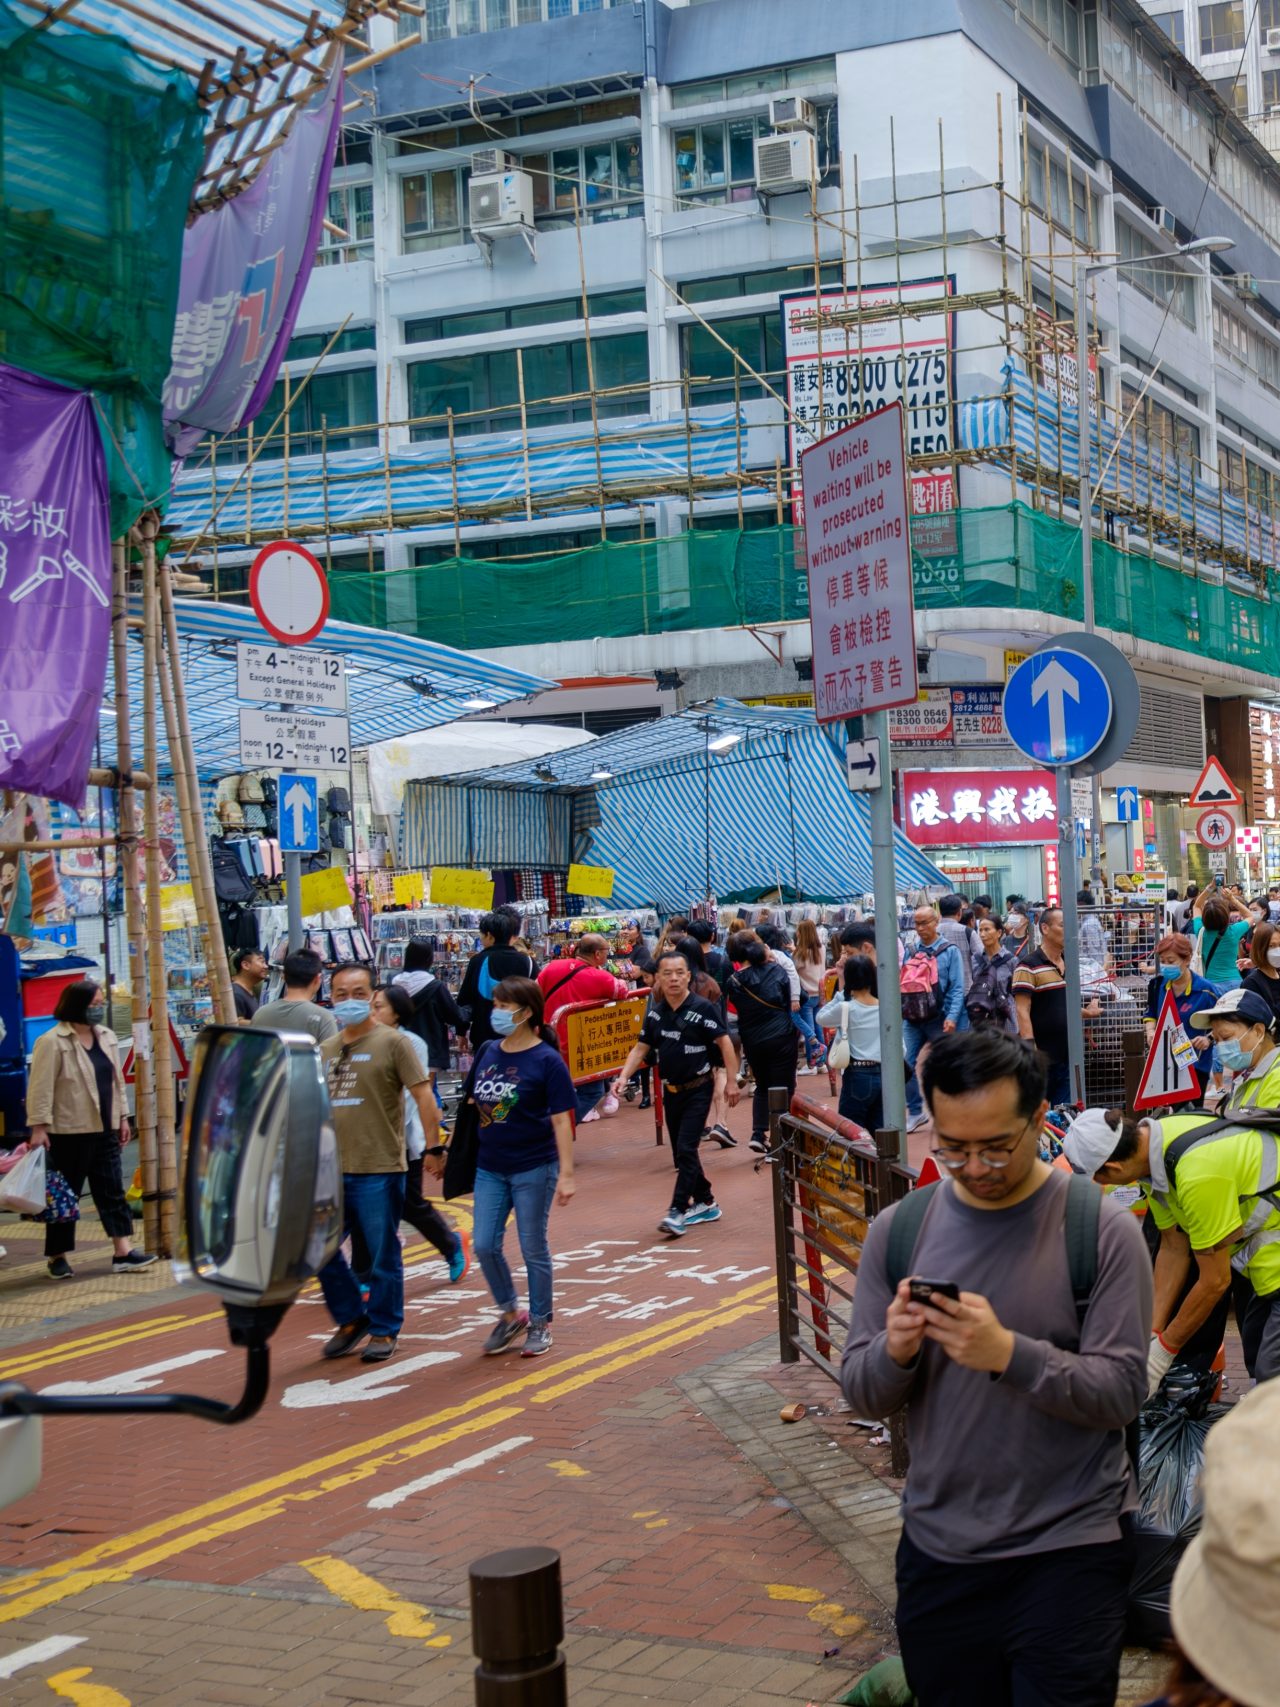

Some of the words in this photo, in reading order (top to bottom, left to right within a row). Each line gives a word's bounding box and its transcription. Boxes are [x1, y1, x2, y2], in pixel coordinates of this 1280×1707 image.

[836, 356, 887, 397] 8300
[894, 348, 946, 389] 0275
[895, 390, 946, 430] 115
[828, 438, 869, 471] Vehicle
[813, 477, 851, 509] waiting
[854, 467, 875, 489] will
[877, 459, 892, 478] be
[822, 489, 885, 538] prosecuted
[811, 537, 851, 569] without
[853, 517, 901, 550] warning
[826, 558, 889, 609] 停車等候
[829, 607, 892, 656] 會被檢控
[245, 658, 263, 669] 下午
[297, 666, 314, 676] 午夜
[290, 653, 321, 664] midnight
[323, 660, 340, 677] 12
[249, 673, 274, 683] Except
[276, 676, 305, 687] General
[307, 680, 336, 692] Holidays
[824, 655, 903, 707] 而不予警告
[896, 709, 921, 717] 8300
[923, 709, 948, 717] 0646
[953, 704, 973, 712] 2812
[974, 704, 993, 712] 4888
[264, 714, 293, 724] General
[295, 717, 326, 727] Holidays
[897, 717, 921, 725] 8300
[955, 717, 980, 732] 王先生
[981, 716, 1002, 734] 8228
[243, 739, 262, 747] noon
[295, 743, 328, 752] midnight
[330, 746, 347, 764] 12
[244, 751, 263, 760] 中午
[584, 1011, 617, 1024] Pedestrian
[618, 1008, 632, 1018] Area
[588, 1020, 631, 1041] 行人專用區
[586, 1039, 612, 1052] Vehicles
[613, 1033, 640, 1045] Prohibite
[473, 1079, 518, 1098] LOOK
